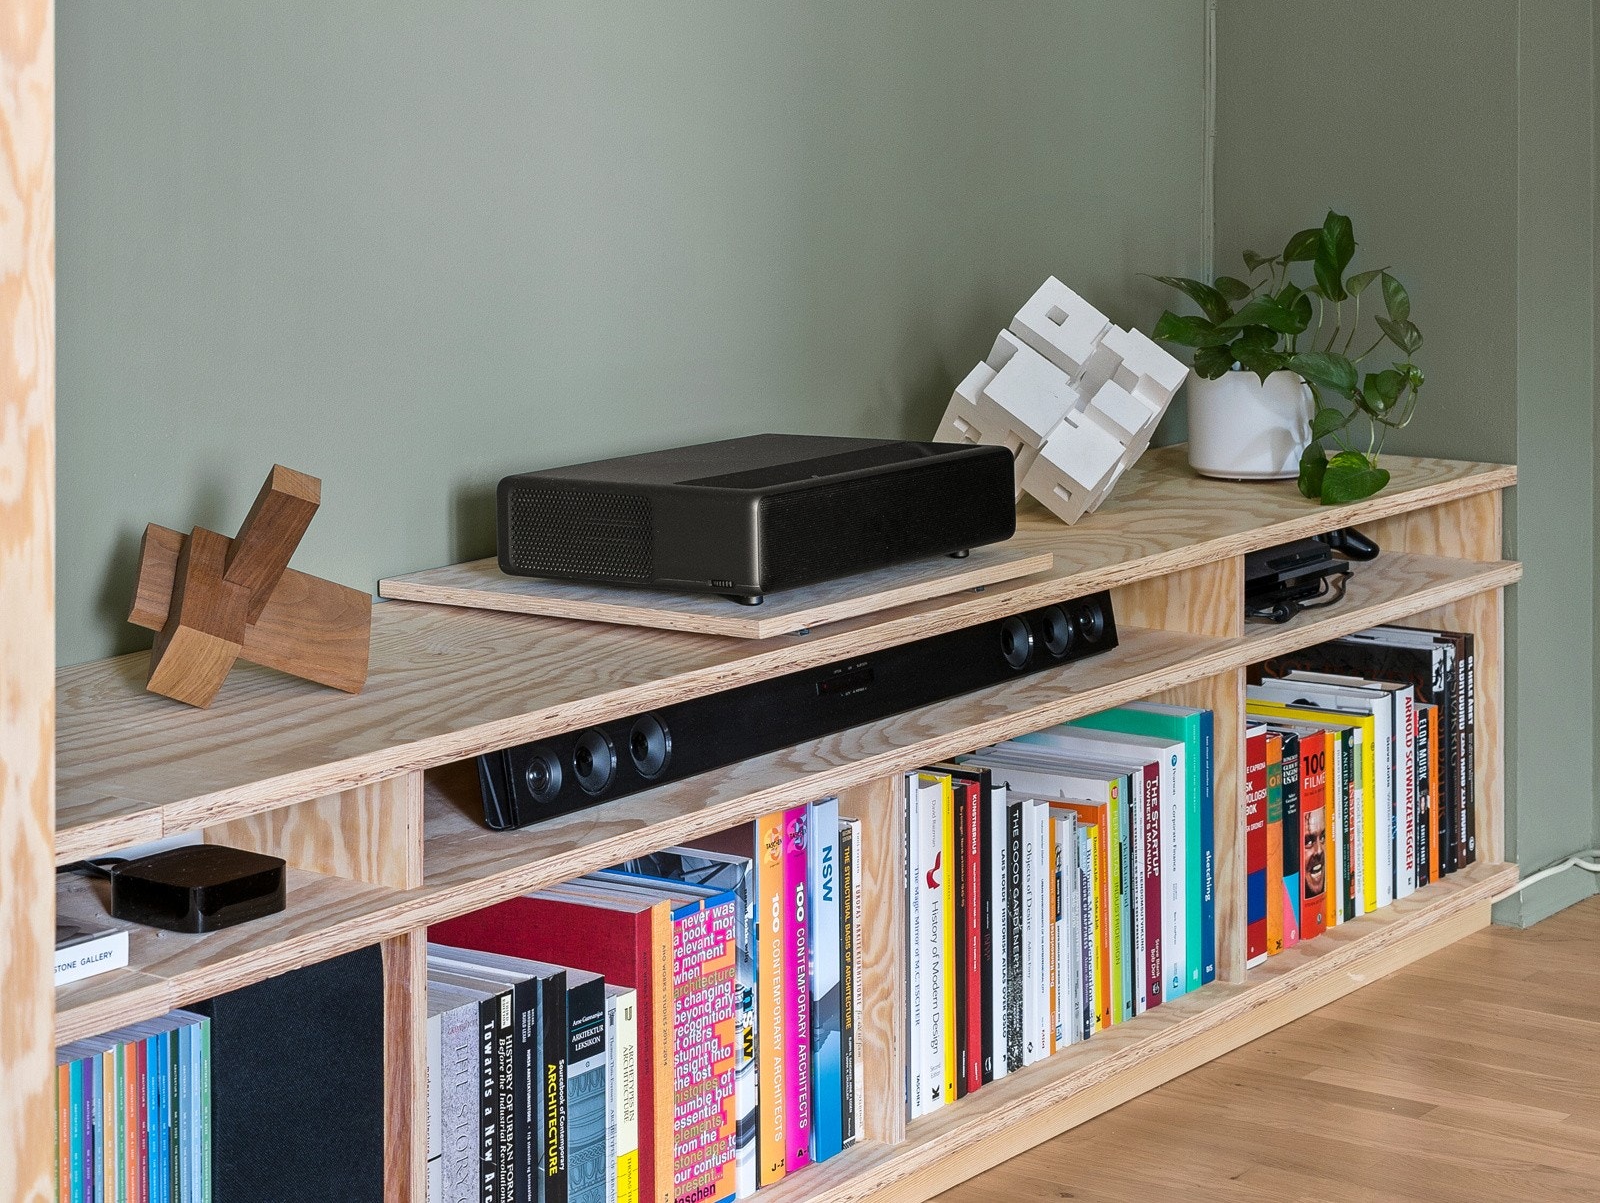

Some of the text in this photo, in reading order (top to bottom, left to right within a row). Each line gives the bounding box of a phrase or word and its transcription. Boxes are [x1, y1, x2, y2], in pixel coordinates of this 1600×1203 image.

[1303, 753, 1326, 776] 100
[1418, 718, 1427, 781] ELON MUSK
[1405, 696, 1414, 871] ARNOLD SCHWARZENEGGER
[1151, 776, 1159, 877] THE STARTUP
[822, 844, 833, 902] NSW
[1012, 840, 1020, 885] GOOD
[1025, 842, 1033, 884] Objects
[1204, 850, 1212, 902] sketching
[912, 886, 920, 914] Magic
[1026, 885, 1033, 896] of
[713, 903, 736, 919] was
[930, 900, 939, 945] History
[674, 934, 715, 957] relevant
[843, 846, 853, 1030] THE STRUCTURAL BASIS OF ARCHITECTURE
[914, 948, 921, 959] of
[932, 946, 940, 959] of
[80, 950, 114, 966] GALLERY
[674, 945, 724, 972] a moment
[674, 967, 700, 986] when
[674, 968, 736, 999] architecture
[932, 960, 940, 1009] Modern
[674, 994, 735, 1026] beyond any
[771, 892, 783, 1142] 100 CONTEMPORARY ARCHITECTS
[796, 881, 809, 1129] 100 CONTEMPORARY ARCHITECTS
[571, 1024, 604, 1043] ARKITEKTUR
[674, 1007, 736, 1038] recognition,
[930, 1012, 940, 1055] Design
[575, 1035, 602, 1051] LEKSIKON
[674, 1038, 719, 1065] stunning
[682, 1029, 713, 1048] offers
[484, 1020, 495, 1098] Towards
[674, 1047, 731, 1076] insight into
[628, 1044, 636, 1122] ARCHETYPES IN
[674, 1065, 712, 1092] the lost
[674, 1070, 732, 1105] histories of
[454, 1041, 470, 1188] THE STORY
[484, 1107, 493, 1116] a
[559, 1106, 566, 1115] of
[674, 1085, 733, 1119] humble but
[674, 1101, 721, 1132] essential
[497, 1038, 508, 1203] Before the Industrial Revolutions
[504, 1034, 515, 1203] HISTORY OF URBAN FORM
[547, 1063, 558, 1177] ARCHITECTURE
[674, 1116, 724, 1144] elements,
[484, 1124, 495, 1162] New
[557, 1115, 565, 1171] Contemporary
[674, 1130, 717, 1159] from the
[674, 1151, 704, 1171] stone
[706, 1141, 726, 1159] age
[674, 1170, 691, 1184] our
[674, 1184, 716, 1203] taschen
